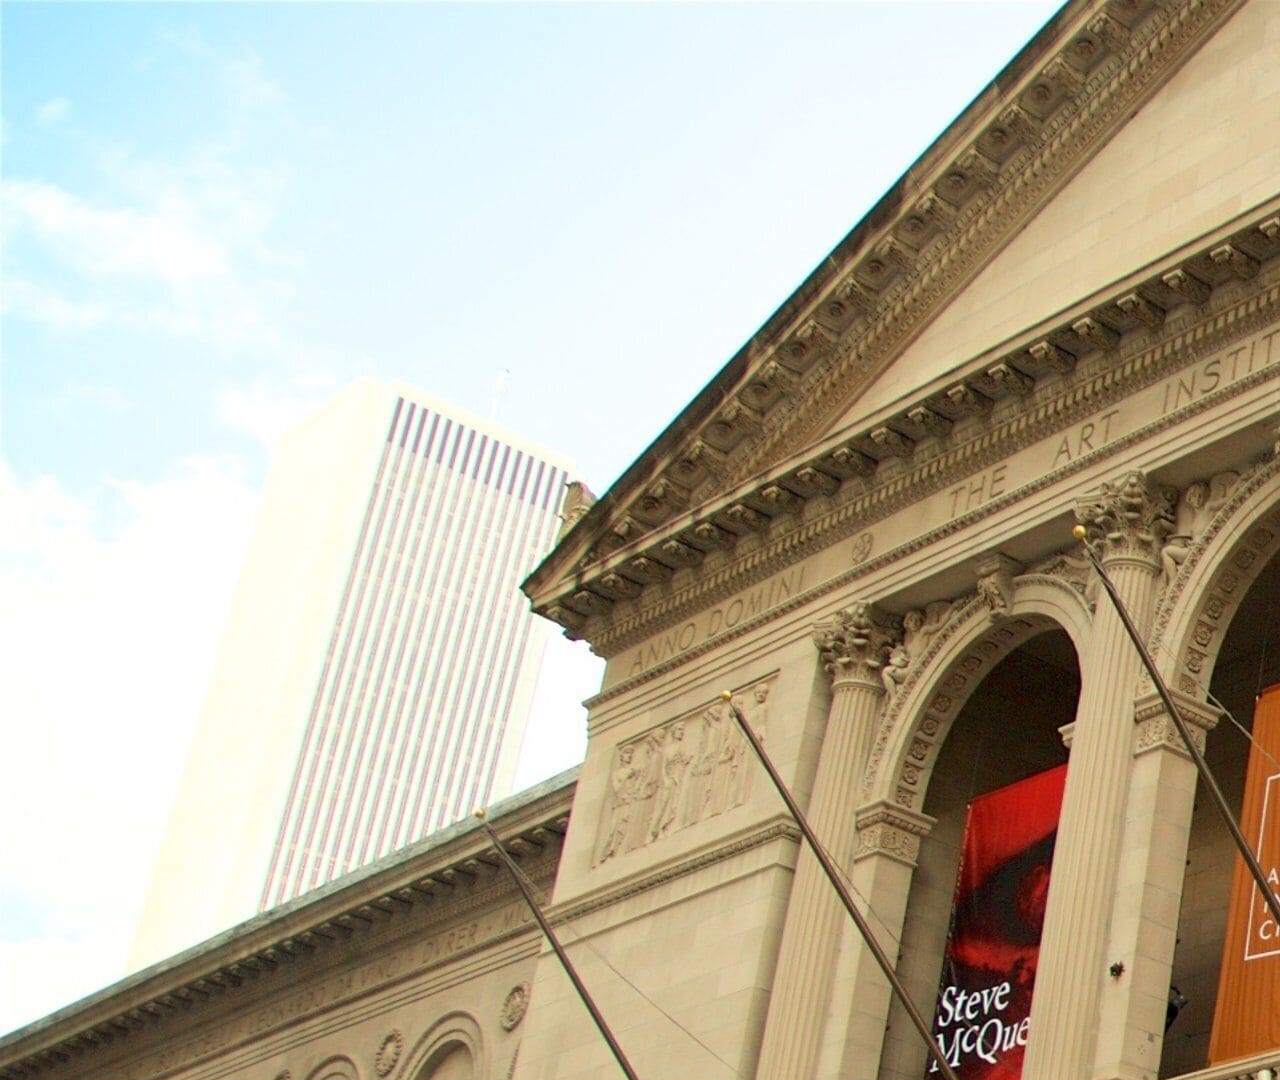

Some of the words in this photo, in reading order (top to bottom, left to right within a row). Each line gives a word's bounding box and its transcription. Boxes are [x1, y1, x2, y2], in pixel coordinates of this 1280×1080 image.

[950, 464, 1007, 518] THE
[1052, 409, 1119, 467] ART
[628, 622, 697, 676] ANNO
[708, 567, 806, 638] DOMINI
[938, 981, 1011, 1027] Steve
